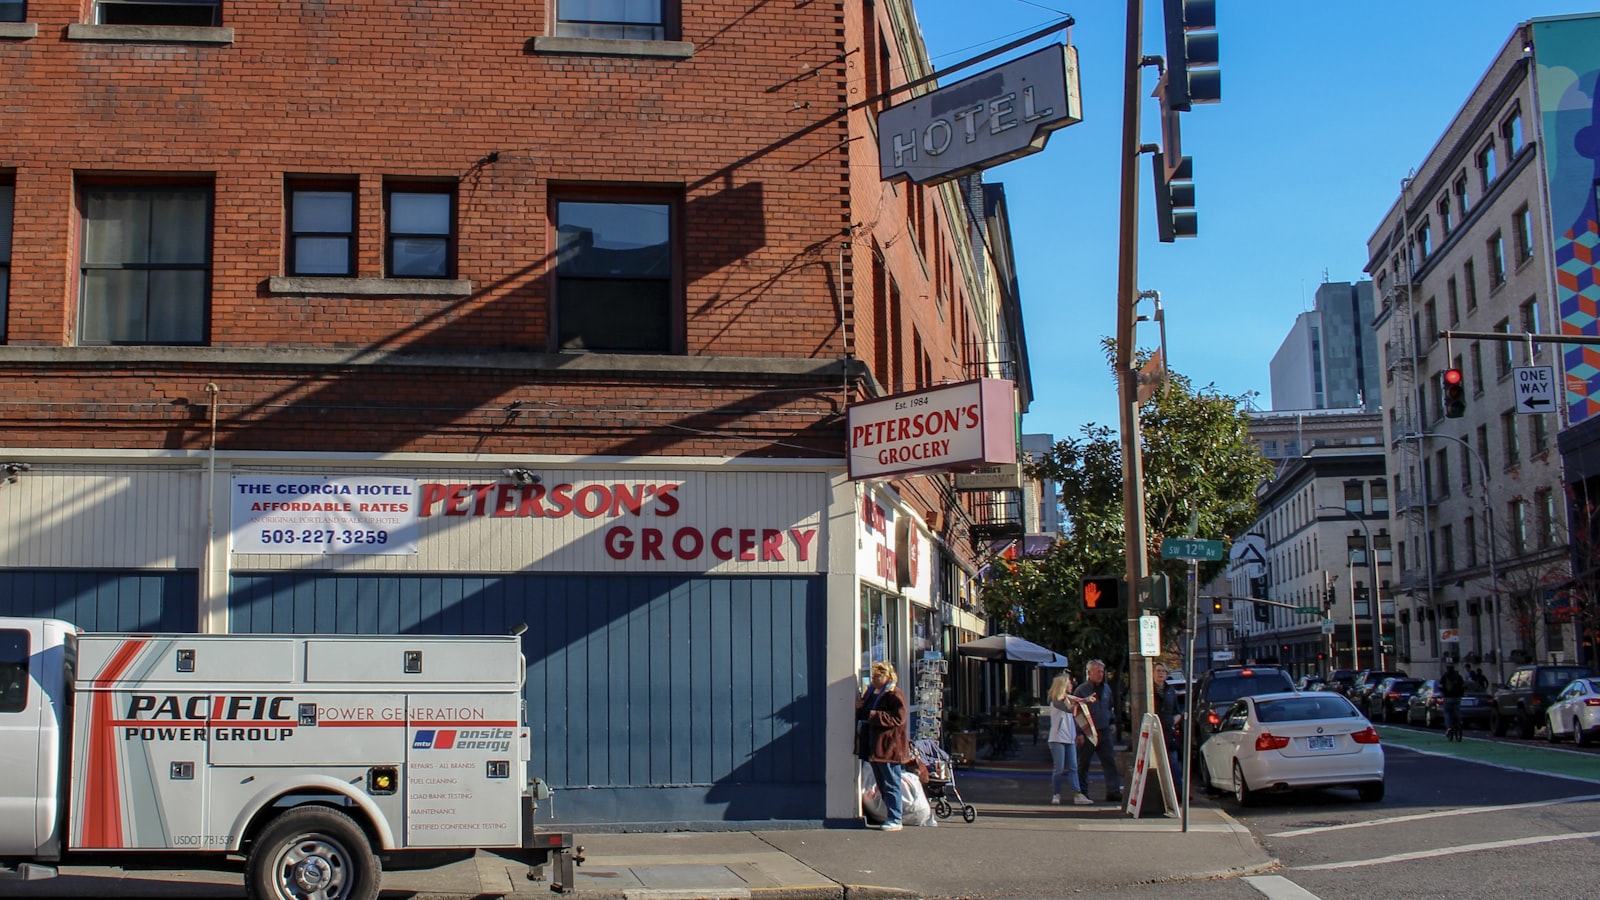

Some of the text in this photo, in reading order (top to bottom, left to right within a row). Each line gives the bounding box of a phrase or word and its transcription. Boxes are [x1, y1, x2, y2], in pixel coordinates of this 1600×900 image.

[892, 85, 1054, 169] HOTEL
[1520, 370, 1547, 381] ONE
[1520, 382, 1548, 394] WAY
[895, 397, 929, 410] Est. 1984
[852, 404, 979, 449] PETERSON'S
[878, 439, 950, 465] GROCERY
[238, 484, 412, 496] THE GEORGIA HOTEL
[418, 483, 679, 518] PETERSON'S
[251, 502, 408, 512] AFFORDABLE RATES
[261, 529, 388, 544] 503-227-3259
[605, 526, 816, 561] GROCERY
[1169, 546, 1180, 554] SW
[126, 696, 294, 720] PACIFIC
[318, 708, 485, 720] POWER GENERATION
[125, 728, 294, 741] POWER GROUP
[459, 728, 513, 739] onsite
[457, 740, 510, 752] energy
[174, 836, 202, 844] USDOT
